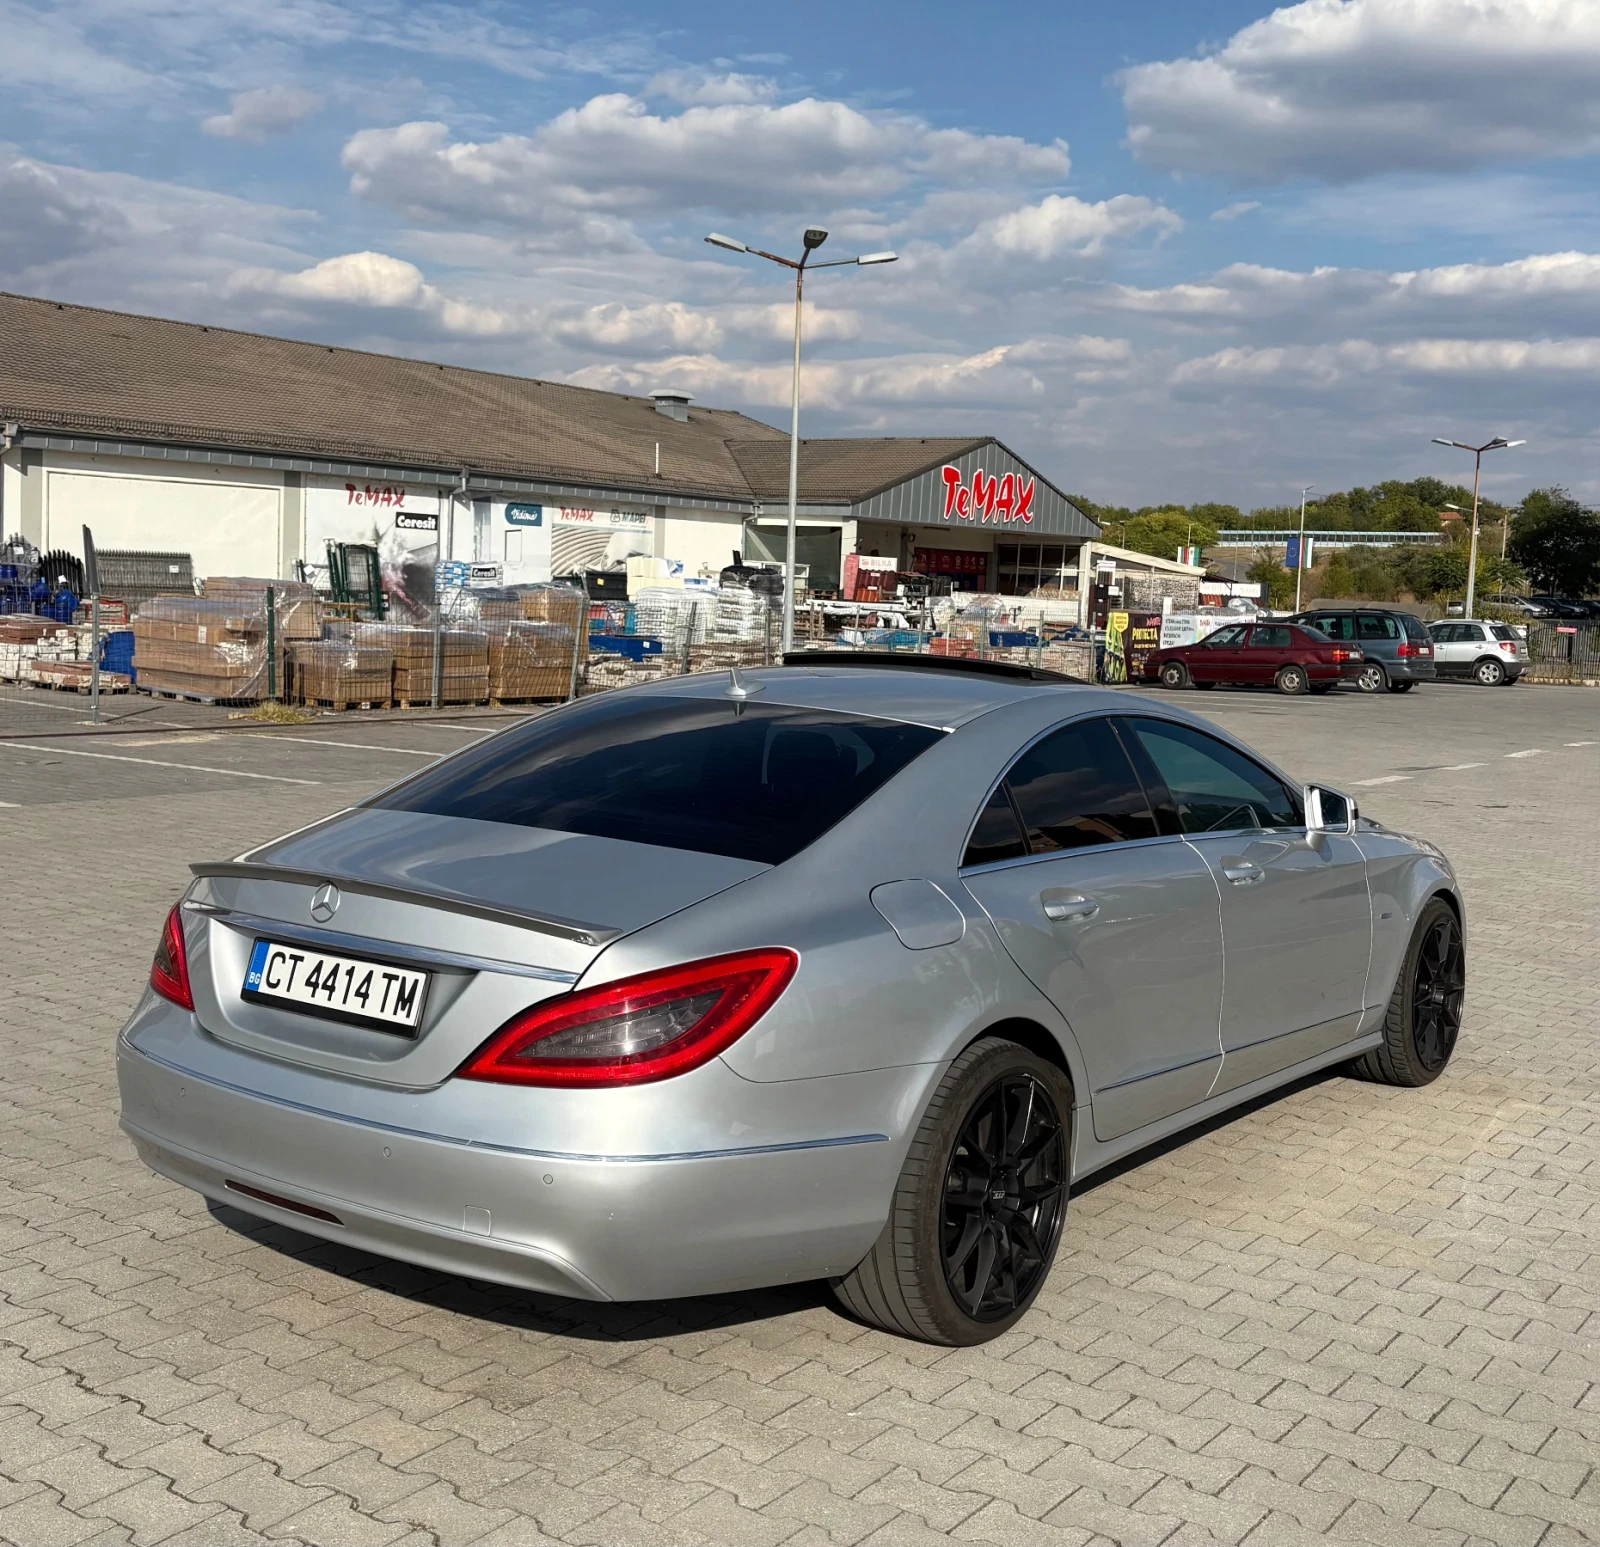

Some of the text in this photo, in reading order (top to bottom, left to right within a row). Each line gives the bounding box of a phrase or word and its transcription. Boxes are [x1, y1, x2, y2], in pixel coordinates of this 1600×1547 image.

[345, 483, 405, 508] TeMAX
[942, 465, 1035, 524] TeMAX
[560, 506, 594, 522] TeMAX
[397, 515, 436, 529] Ceresit
[870, 557, 892, 567] BILKA
[473, 569, 496, 577] Ceresit
[249, 972, 261, 985] BG
[265, 951, 420, 1019] CT 4414 TM
